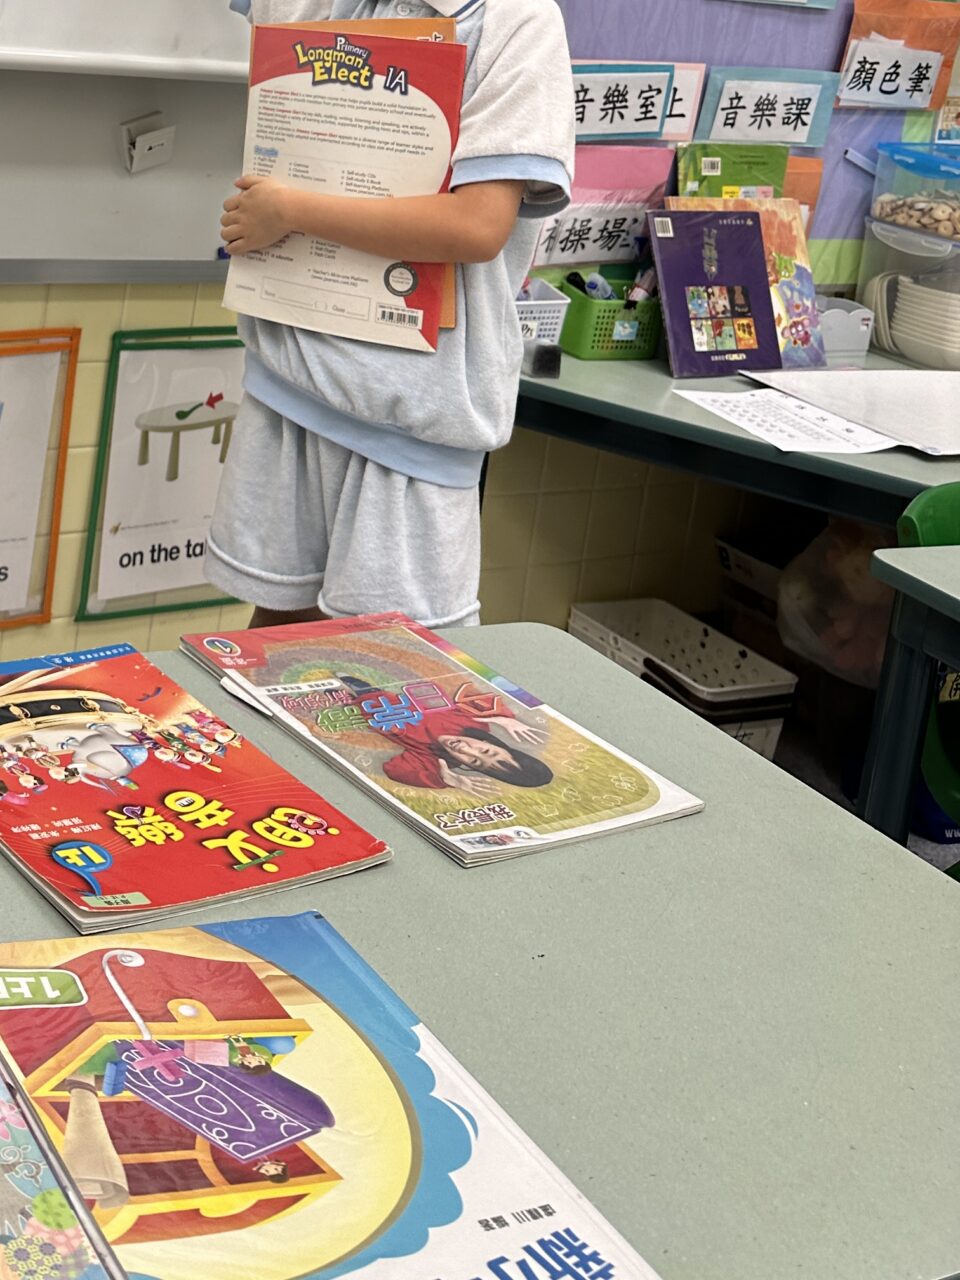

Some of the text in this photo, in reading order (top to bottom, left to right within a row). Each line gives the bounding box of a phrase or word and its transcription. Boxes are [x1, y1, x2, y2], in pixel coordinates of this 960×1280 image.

[294, 42, 365, 69] Longman
[335, 35, 370, 59] Primary
[313, 60, 407, 93] Elect 1A
[844, 54, 933, 99] 顏色筆
[574, 82, 663, 125] 音樂室
[720, 90, 813, 131] 音樂課
[559, 216, 625, 254] 操場
[119, 550, 145, 569] on
[149, 542, 181, 564] the
[315, 681, 502, 735] 今日常識
[106, 790, 237, 848] 音樂
[435, 804, 516, 830] 我長大了
[54, 845, 107, 868] 1上
[200, 806, 341, 874] 朗文
